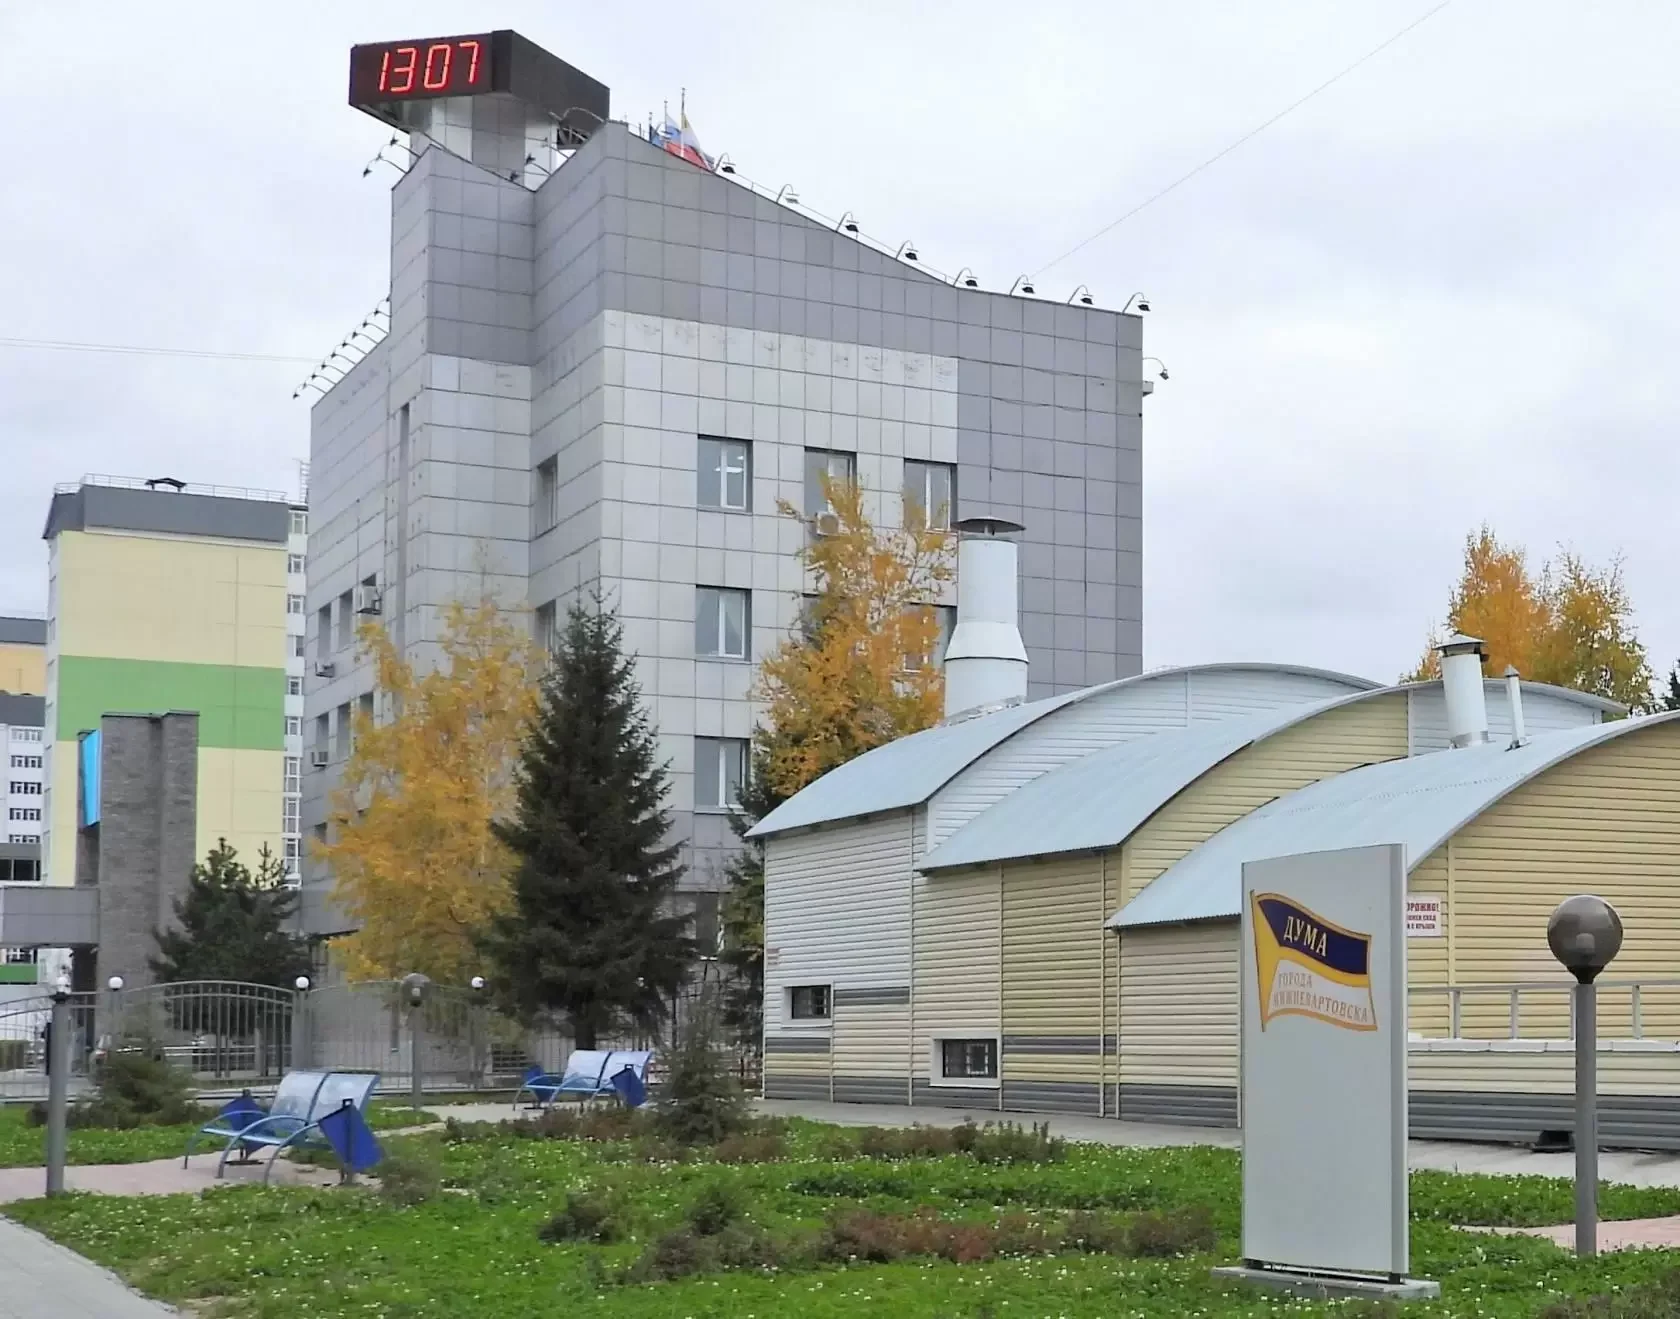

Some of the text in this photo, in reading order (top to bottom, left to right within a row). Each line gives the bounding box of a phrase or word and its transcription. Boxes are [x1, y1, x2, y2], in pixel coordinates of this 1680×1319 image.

[379, 41, 479, 92] 1307
[1283, 915, 1328, 957] ДУМА
[1279, 971, 1313, 989] ГОРОДА
[1273, 990, 1368, 1023] НИЖНЕВАРТОВСКА
